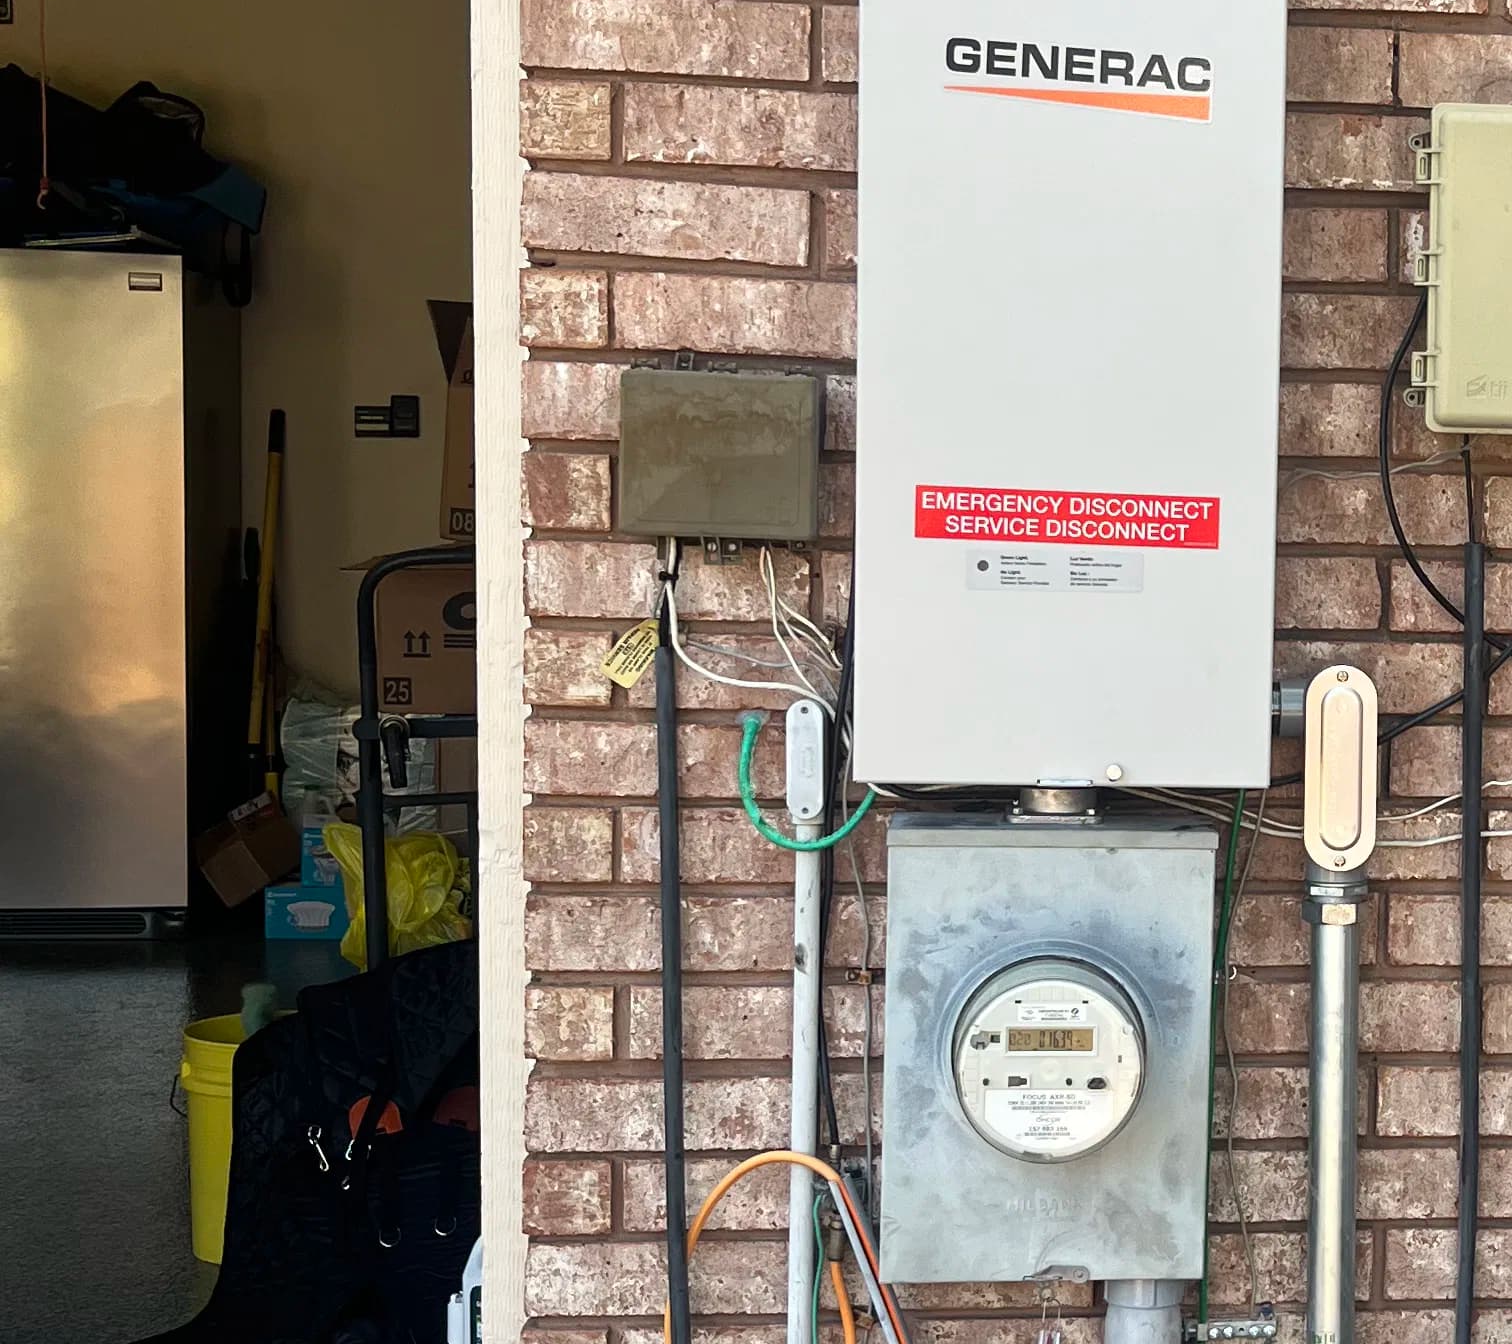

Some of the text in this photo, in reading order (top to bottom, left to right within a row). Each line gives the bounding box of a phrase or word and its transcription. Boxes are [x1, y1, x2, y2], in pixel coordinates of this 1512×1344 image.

[945, 36, 1211, 93] GENERAC
[921, 491, 1214, 520] EMERGENCY DISCONNECT
[945, 515, 1190, 542] SERVICE DISCONNECT
[385, 681, 409, 703] 25
